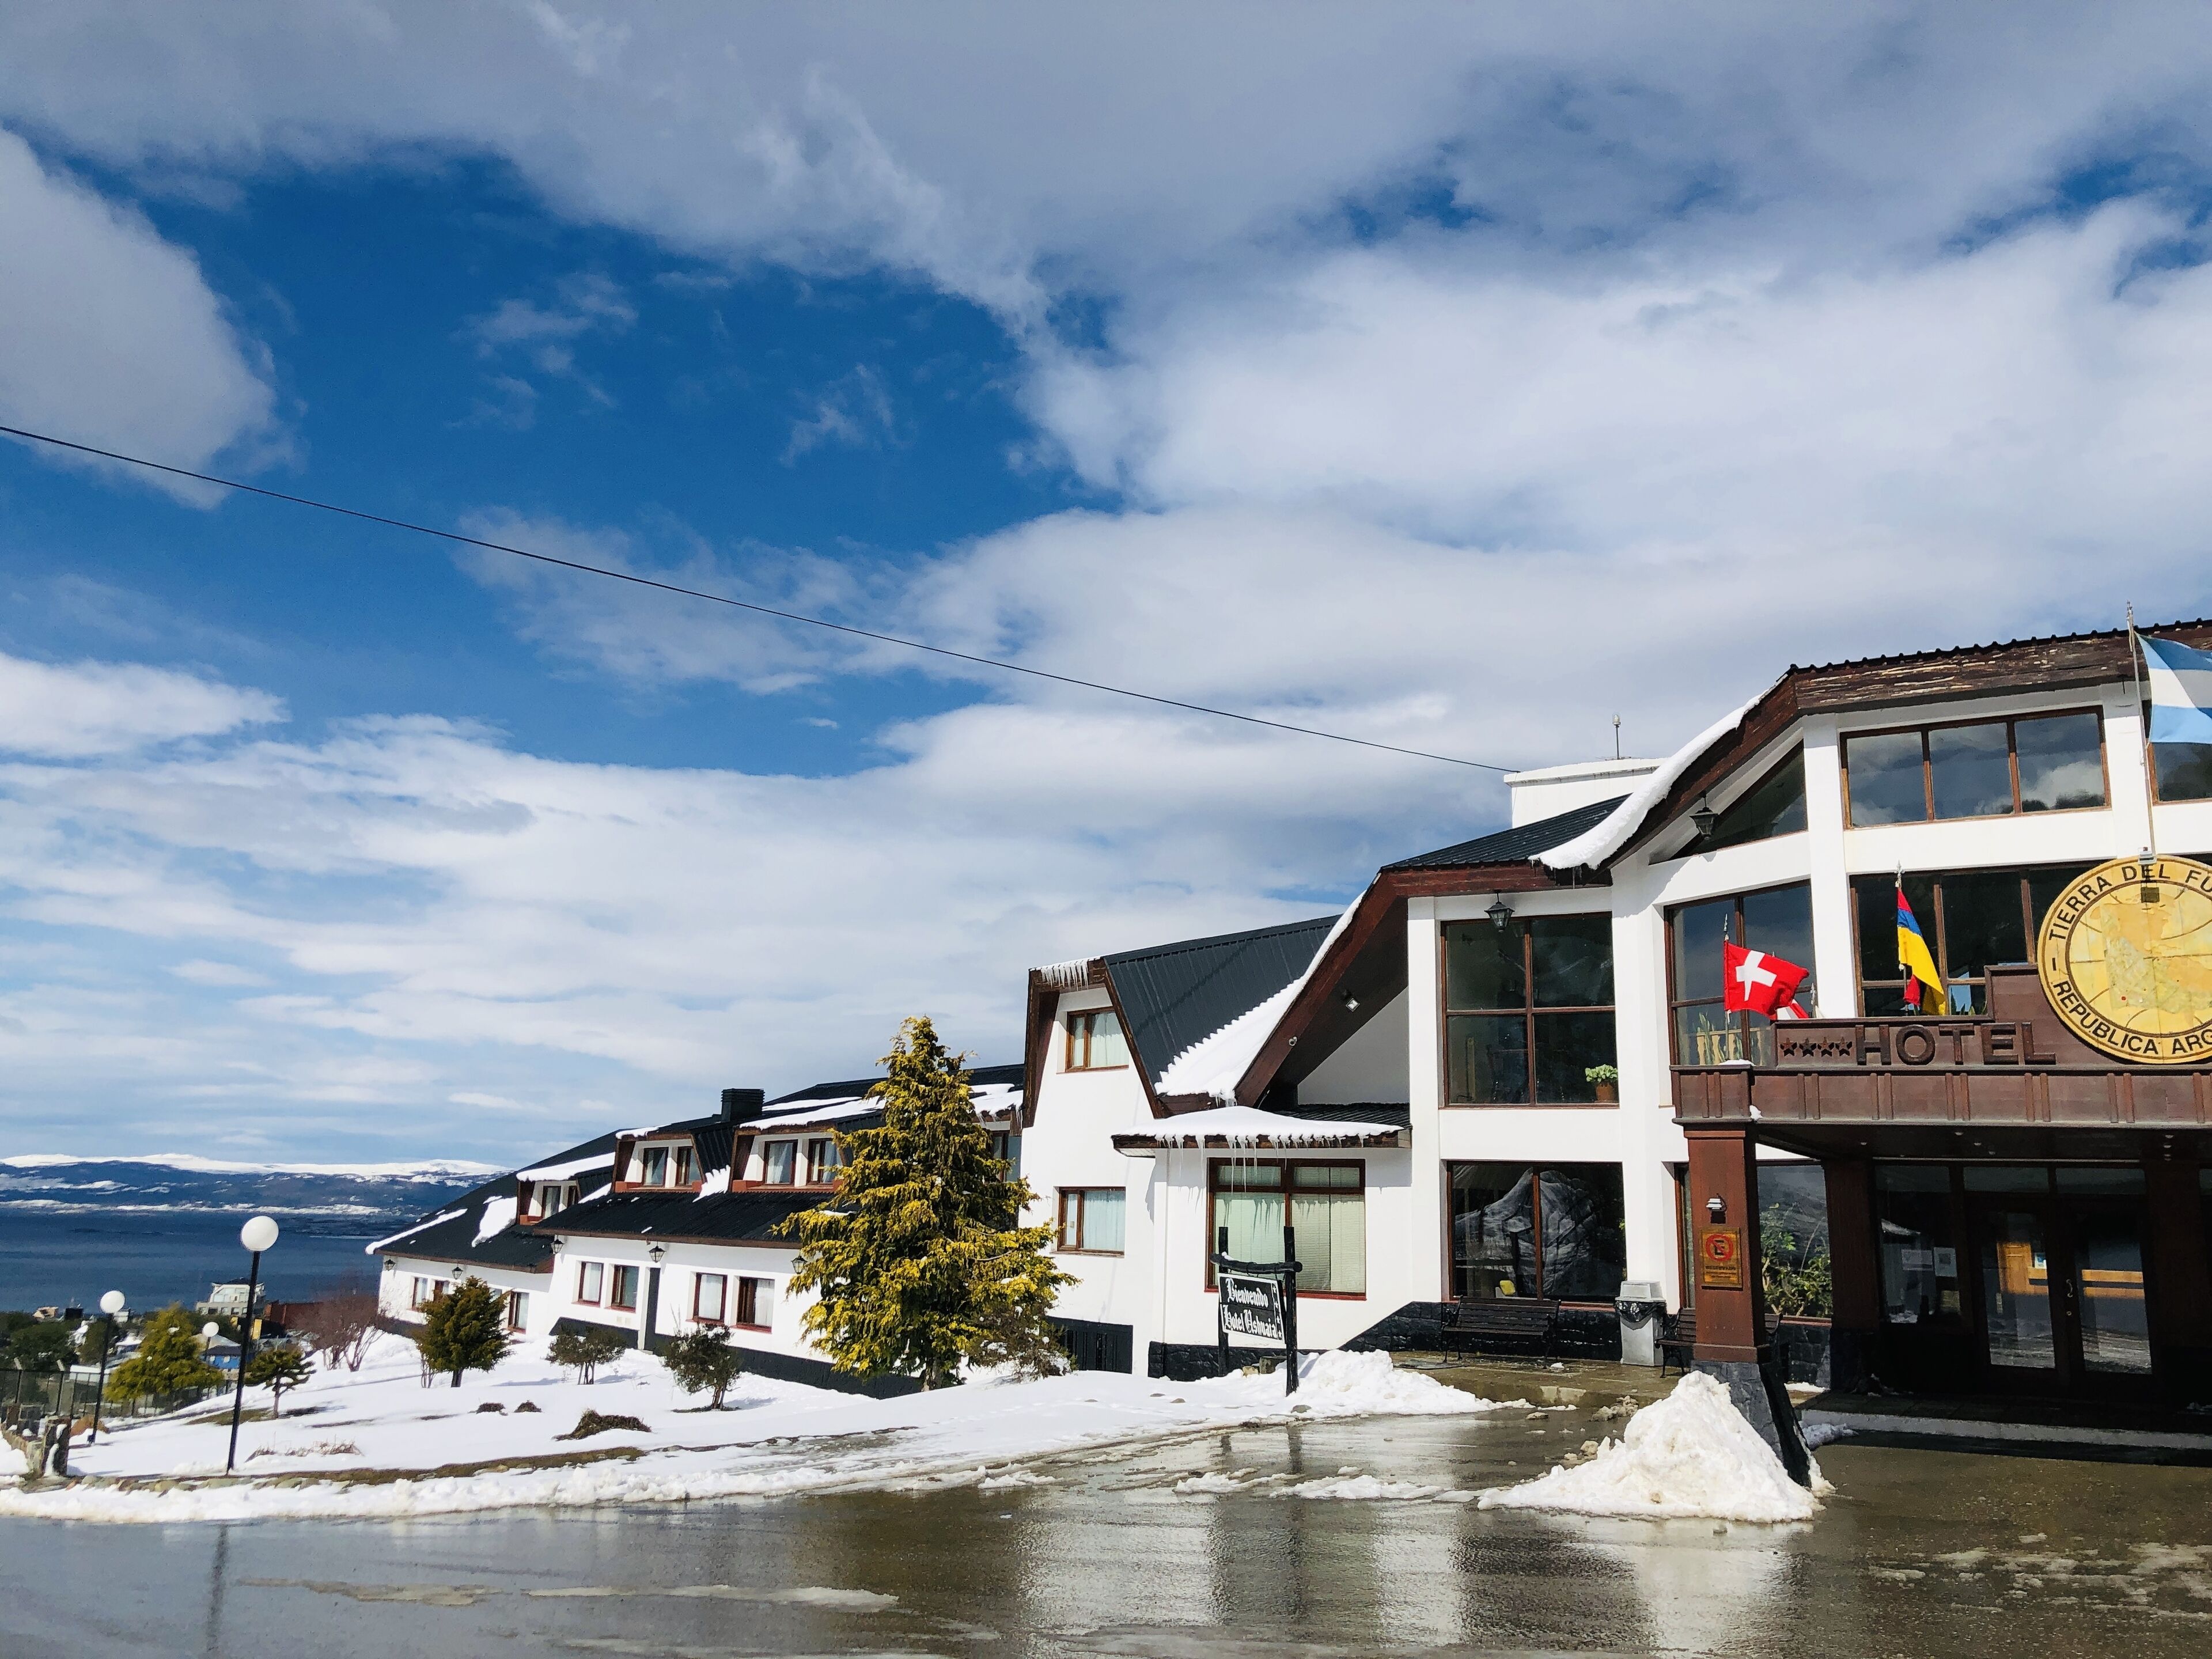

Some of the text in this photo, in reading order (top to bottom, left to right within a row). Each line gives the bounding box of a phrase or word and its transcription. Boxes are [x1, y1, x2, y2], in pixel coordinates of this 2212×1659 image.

[2049, 876, 2112, 941] TIERRA
[2122, 864, 2171, 880] DEL
[2053, 981, 2158, 1054] REPUBLICA
[1855, 1022, 2056, 1065] HOTEL
[1226, 1278, 1268, 1308] Bienvenido
[1224, 1305, 1277, 1338] Hotel Ushuaia
